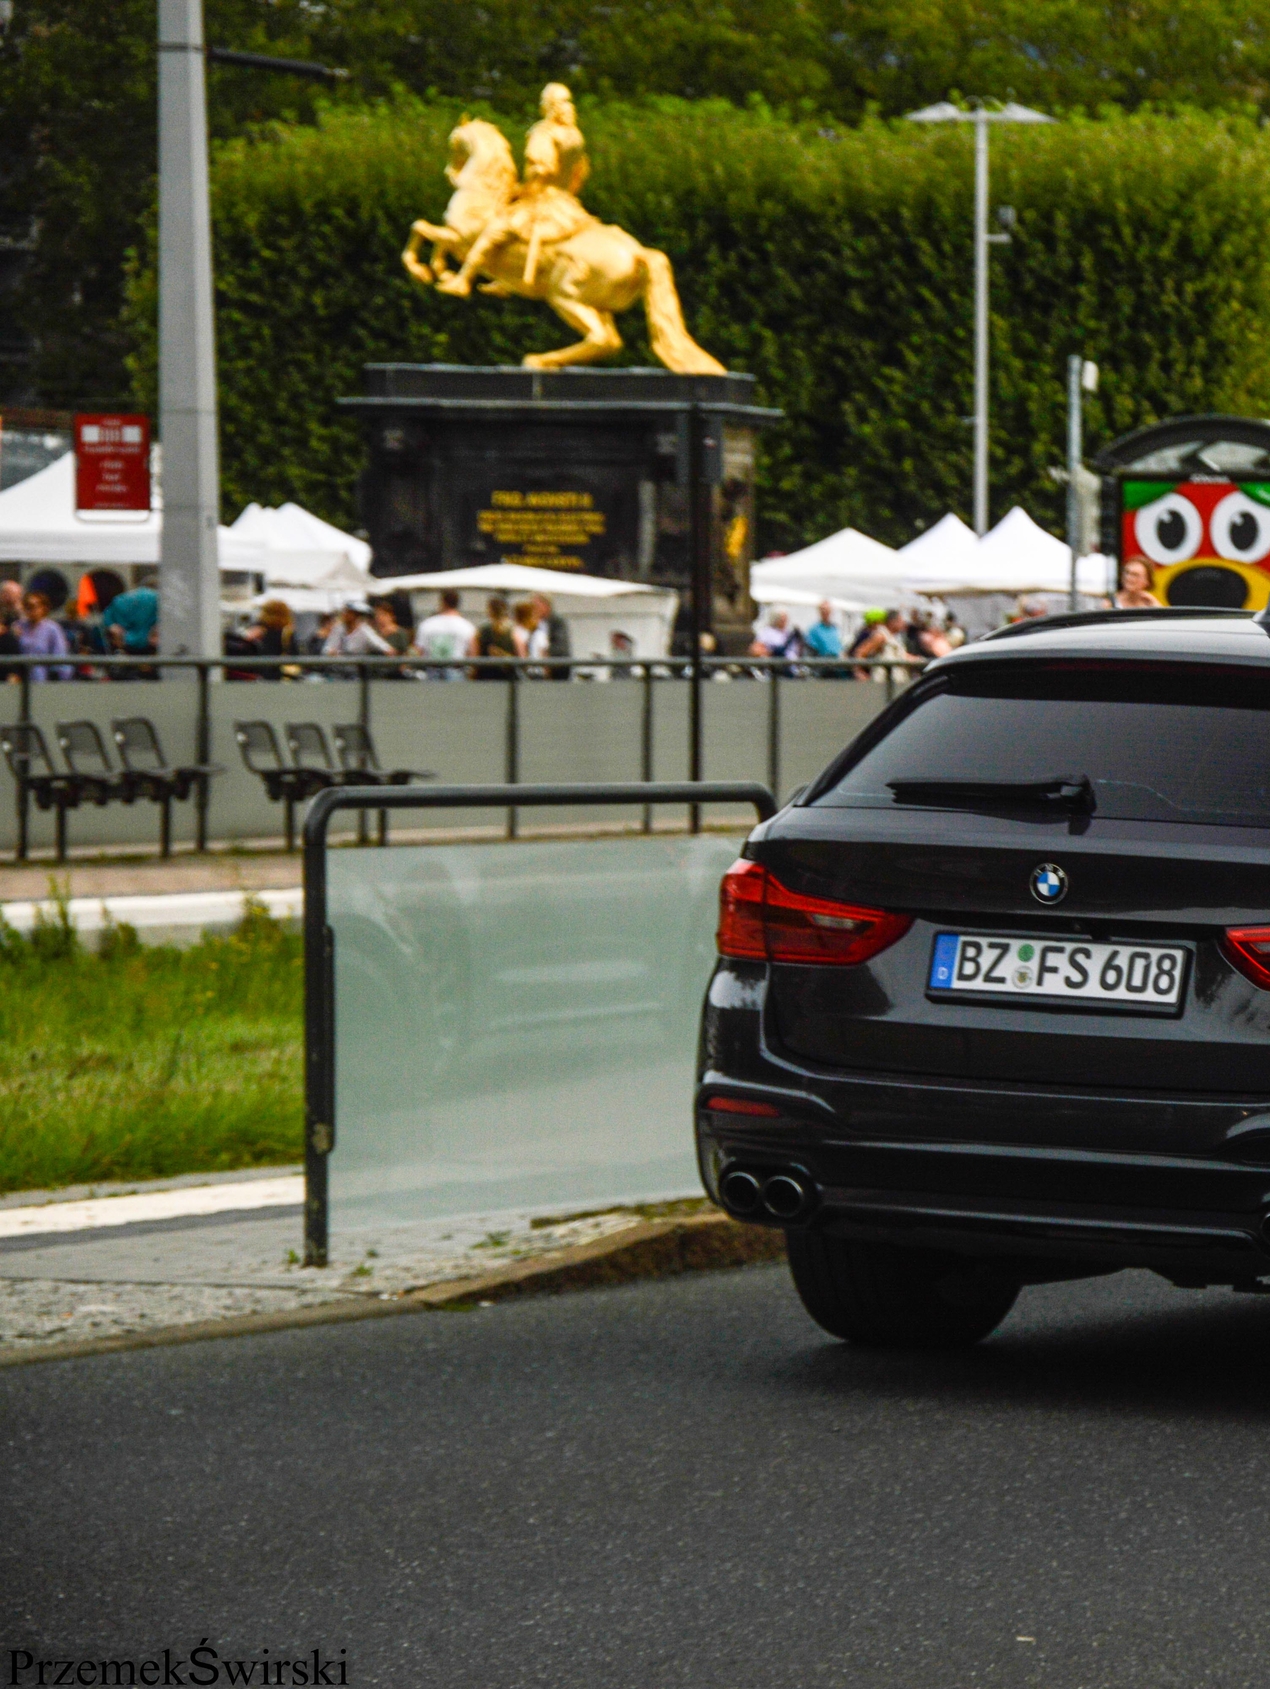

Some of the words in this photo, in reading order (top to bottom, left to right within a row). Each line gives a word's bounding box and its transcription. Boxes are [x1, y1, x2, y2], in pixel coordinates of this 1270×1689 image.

[956, 940, 1011, 984] BZ
[1036, 945, 1092, 990] FS
[1099, 950, 1179, 996] 608
